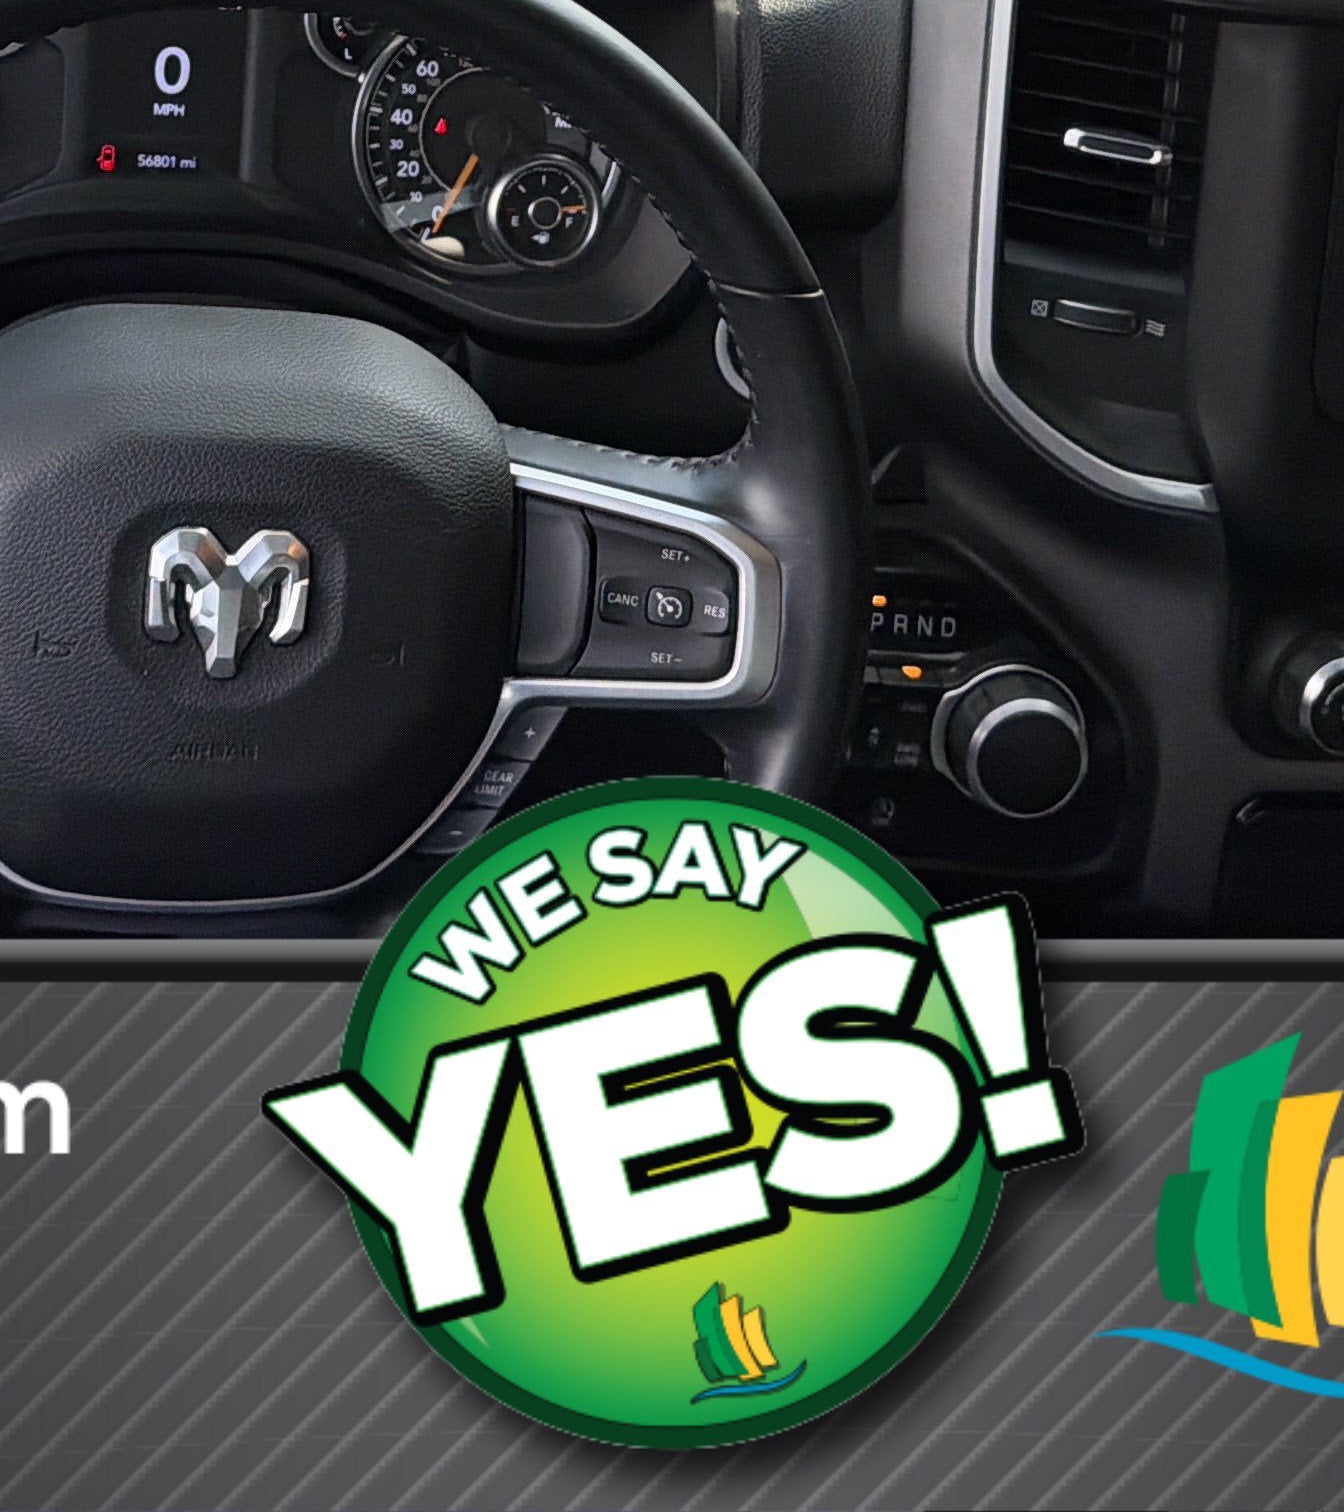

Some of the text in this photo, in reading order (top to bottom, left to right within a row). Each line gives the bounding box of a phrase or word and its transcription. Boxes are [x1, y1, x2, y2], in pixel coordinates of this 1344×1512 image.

[343, 47, 353, 61] L
[154, 46, 191, 95] 0
[416, 60, 439, 77] 60
[401, 83, 417, 95] 50
[153, 102, 186, 117] MPH
[390, 108, 413, 126] 40
[389, 138, 404, 150] 30
[137, 153, 196, 170] 56801 mi
[397, 160, 420, 178] 20
[409, 191, 423, 203] 10
[431, 205, 443, 222] 0
[510, 215, 520, 227] E
[607, 592, 639, 607] CANC
[703, 605, 726, 619] RES
[484, 770, 514, 783] GEAR
[474, 784, 505, 796] LIMIT
